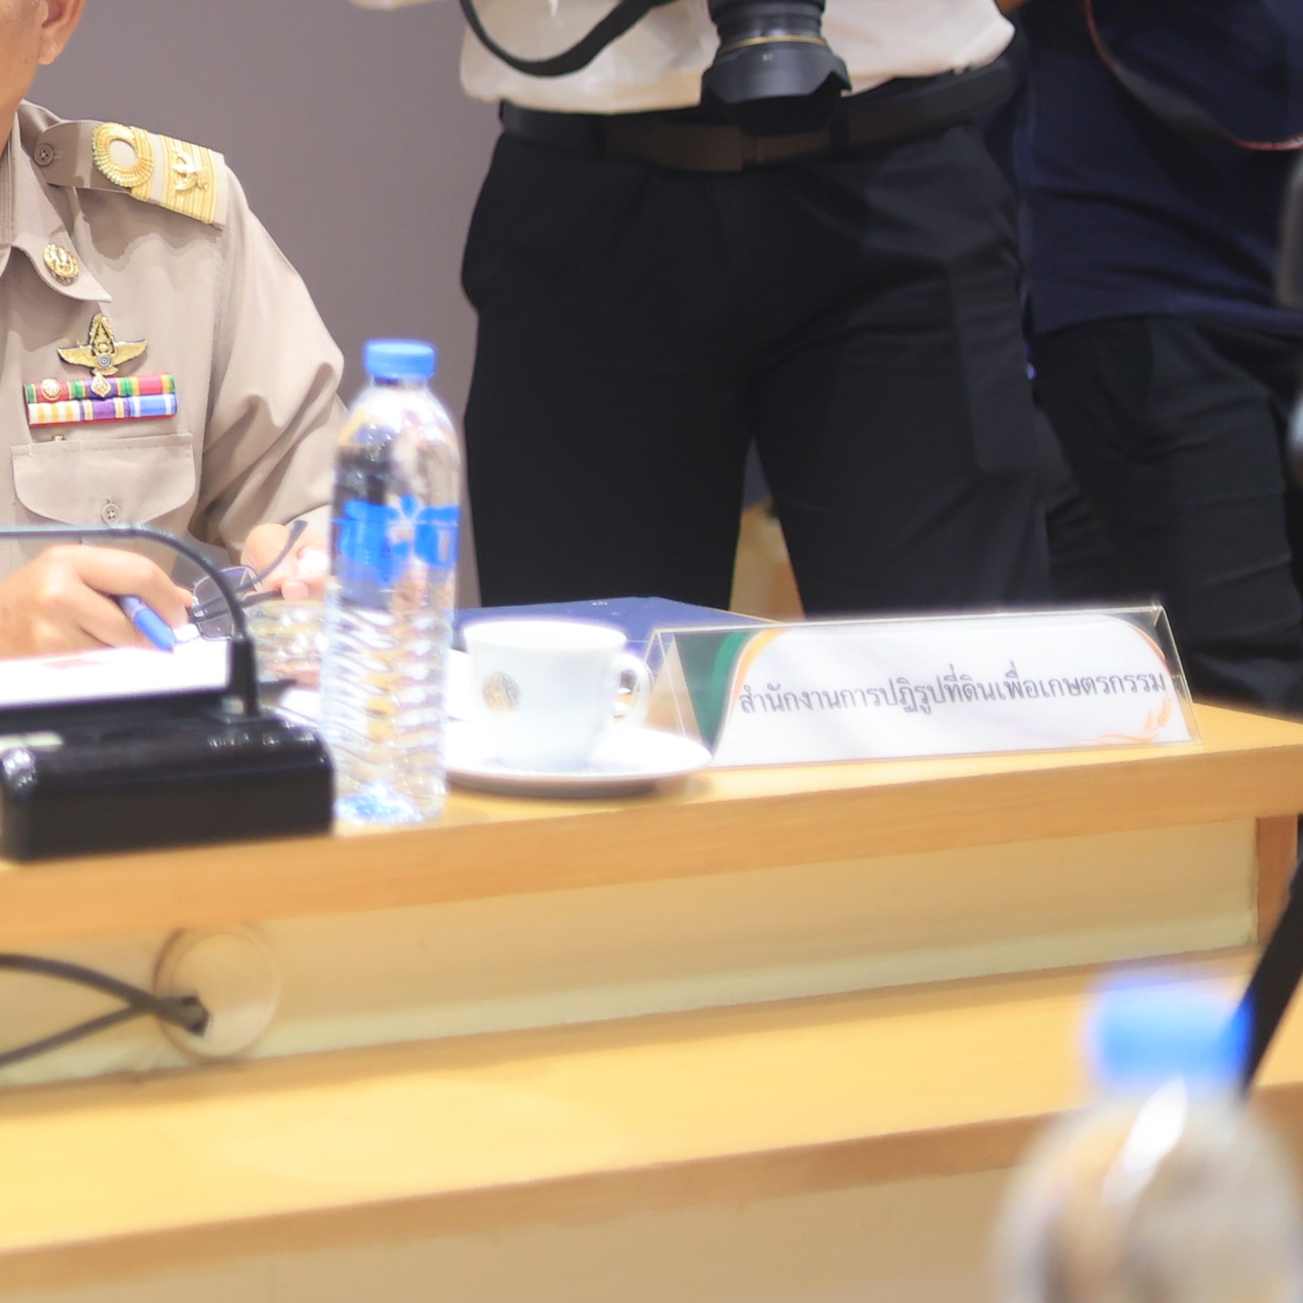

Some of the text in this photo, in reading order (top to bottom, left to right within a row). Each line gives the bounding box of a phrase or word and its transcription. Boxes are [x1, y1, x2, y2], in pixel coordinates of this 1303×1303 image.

[738, 660, 1166, 715] สำนักงานการปฏิรูปที่ดินเพื่อเกษตรกรรม
